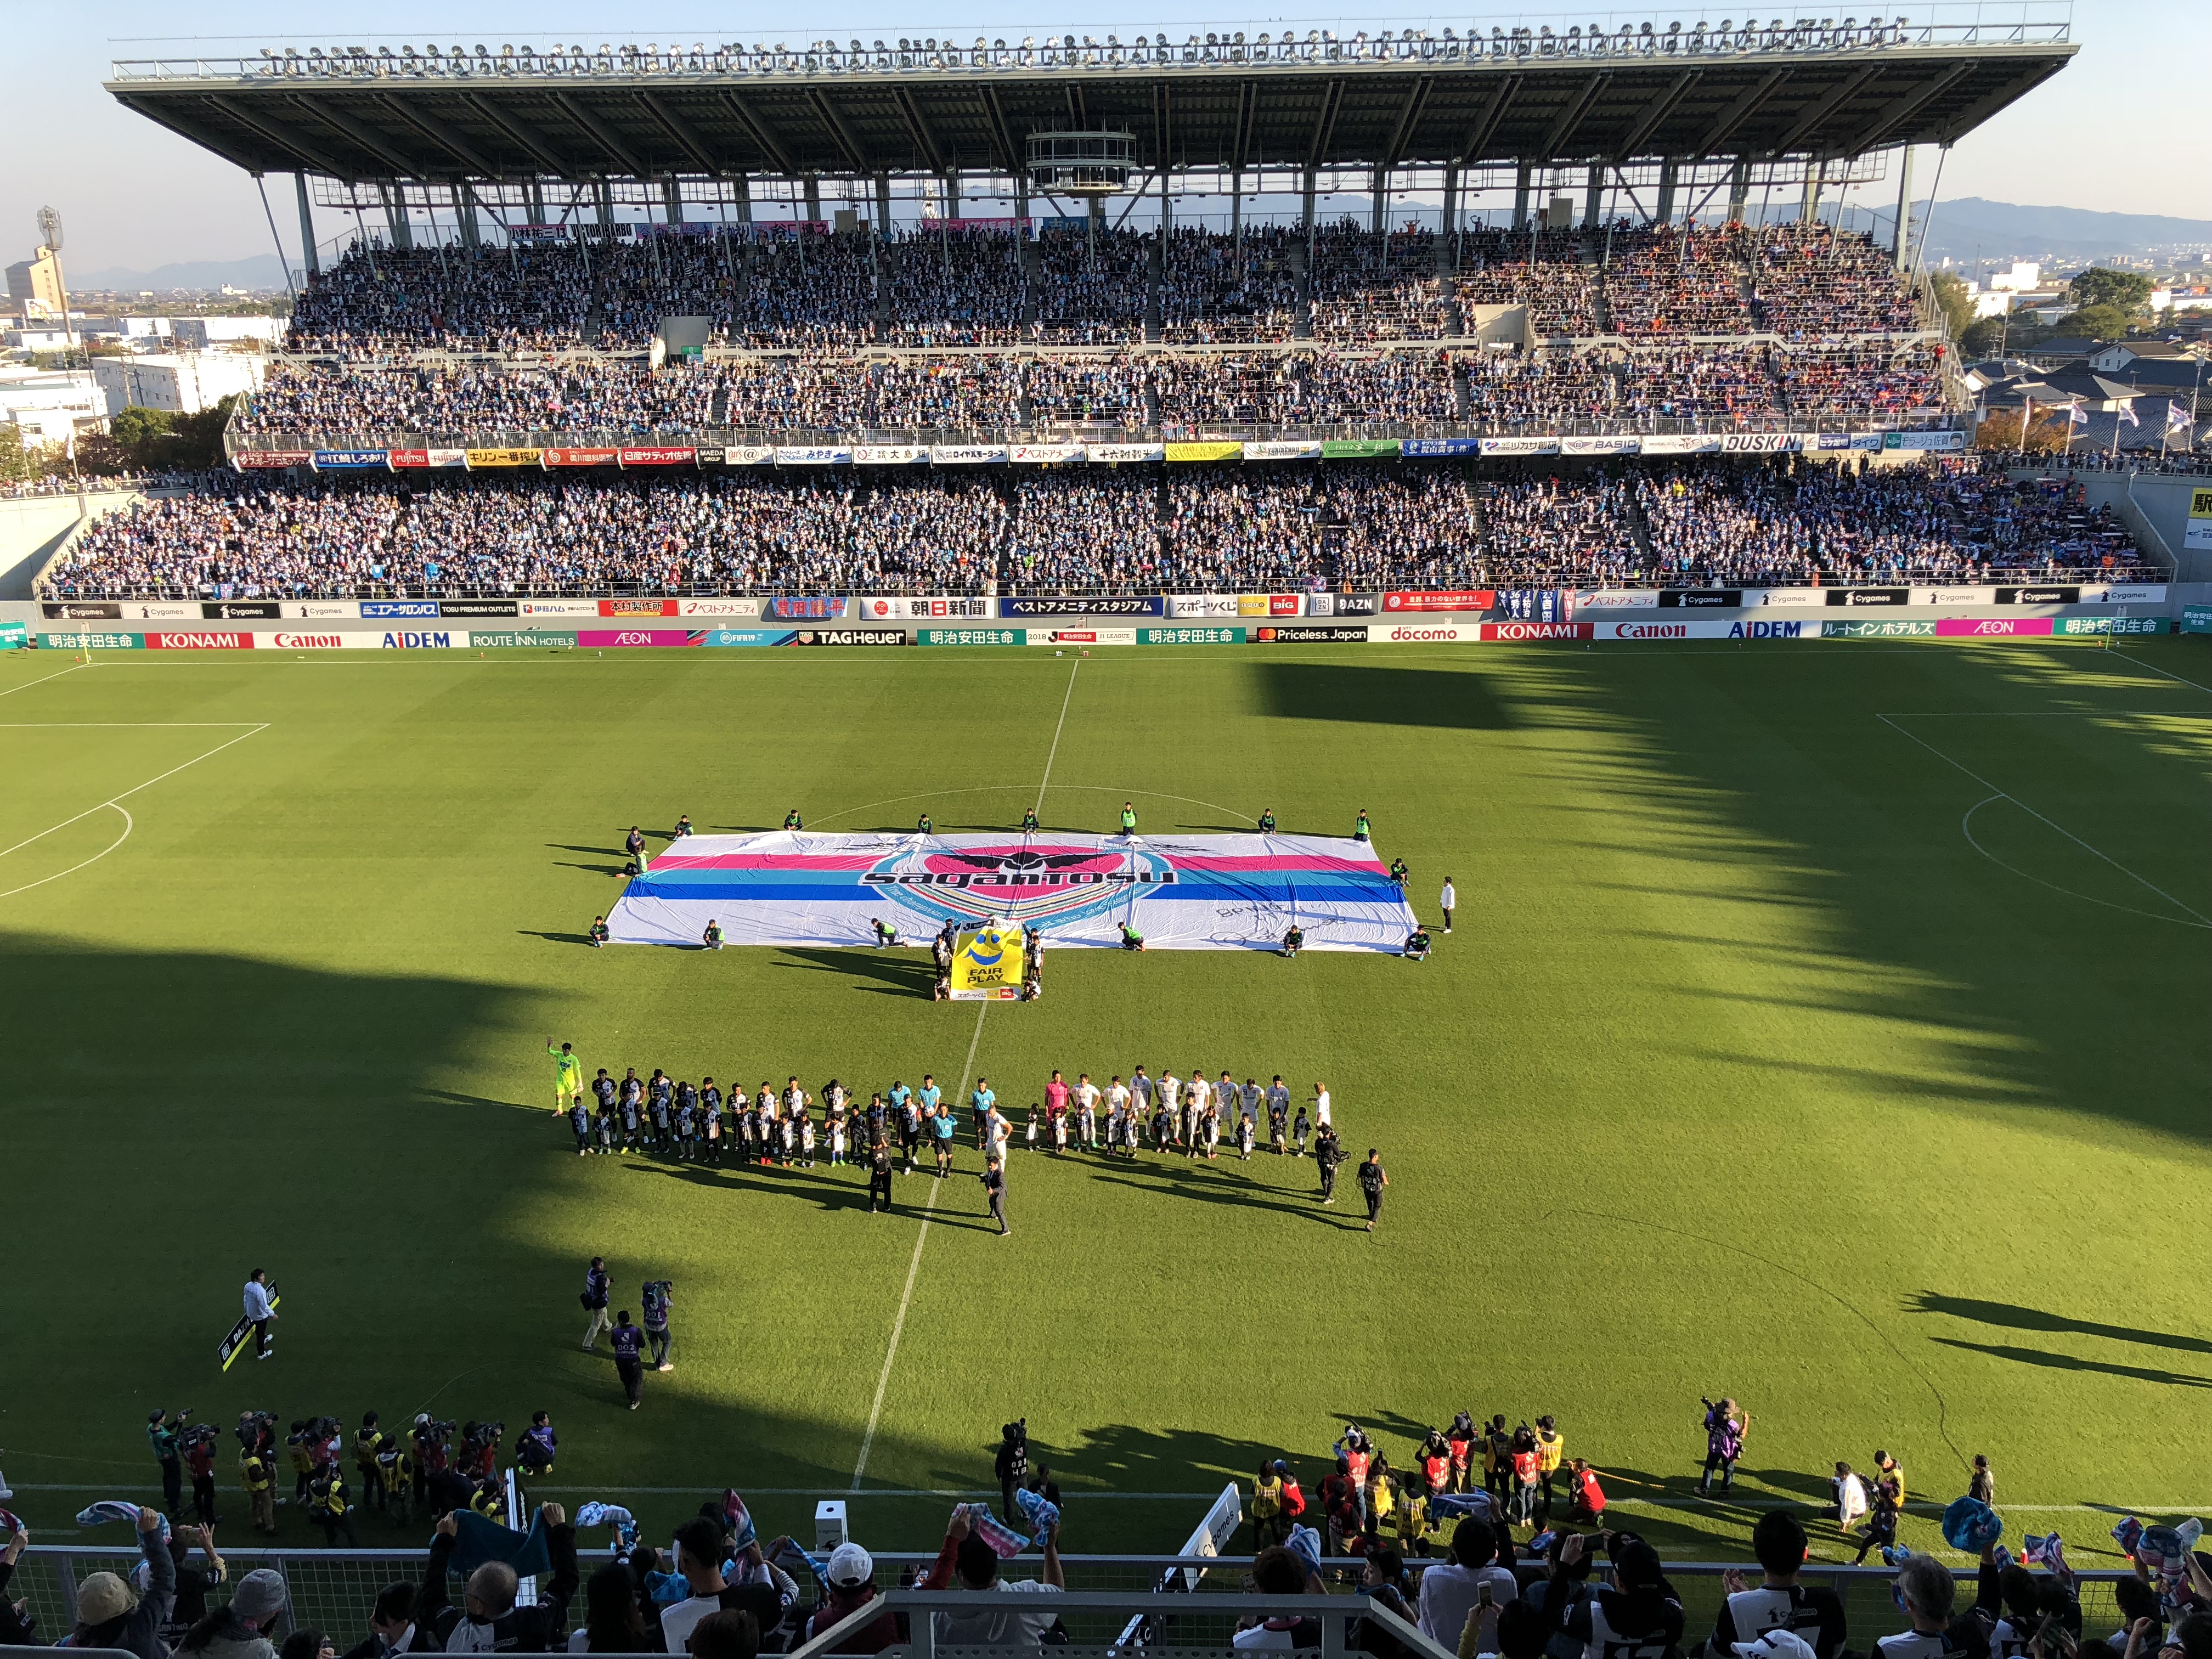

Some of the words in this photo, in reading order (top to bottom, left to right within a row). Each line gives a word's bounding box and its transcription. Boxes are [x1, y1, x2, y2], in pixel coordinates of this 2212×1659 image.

[510, 227, 555, 240] 小林祐三
[556, 227, 566, 238] 13
[668, 224, 681, 234] 29
[1511, 441, 1557, 450] ツカサ創研
[1595, 439, 1637, 449] BASIC
[1726, 435, 1798, 450] DUSKIN
[1852, 439, 1878, 448] ダイワ
[1902, 435, 1949, 447] モラージュ佐賀
[470, 452, 539, 462] キリン一番搾り
[625, 452, 691, 460] 日産サティオ佐賀
[806, 450, 832, 459] みやぎ
[890, 449, 926, 459] 大島組
[1028, 449, 1082, 458] ベストアメニティ
[396, 455, 425, 464] FUJITSU
[433, 455, 461, 464] FUJITSU
[1595, 596, 1654, 606] ベストアメニティ
[2024, 592, 2061, 601] Cygames
[2111, 591, 2147, 600] Cygames
[377, 605, 436, 615] エアーサロンパス
[610, 601, 663, 612] 本村製作所
[698, 605, 755, 614] ベストアメニティ
[911, 600, 986, 616] 朝日新聞
[1013, 601, 1152, 612] ベストアメニティスタジアム
[1177, 600, 1237, 612] スポーツくじ
[1339, 599, 1372, 610] DAZN
[1511, 599, 1520, 618] 秀人
[1542, 600, 1552, 622] 吉田
[1497, 625, 1578, 639] KONAMI
[1615, 623, 1686, 638] Canon
[2066, 620, 2157, 634] 明治安田生命
[930, 631, 1014, 645] 明治安田生命
[1149, 629, 1233, 643] 明治安田生命
[1330, 629, 1366, 642] Japan
[1391, 627, 1457, 640] docomo
[49, 634, 133, 648] 明治安田生命
[161, 634, 239, 647] KONAMI
[274, 633, 341, 647] Canon
[473, 635, 512, 647] ROUTE
[540, 637, 574, 646] HOTELS
[970, 967, 1002, 976] FAIR
[967, 974, 1004, 984] PLAY
[1203, 1510, 1234, 1557] Cygames
[1780, 1608, 1817, 1617] Cyames
[481, 1637, 518, 1650] Cygames
